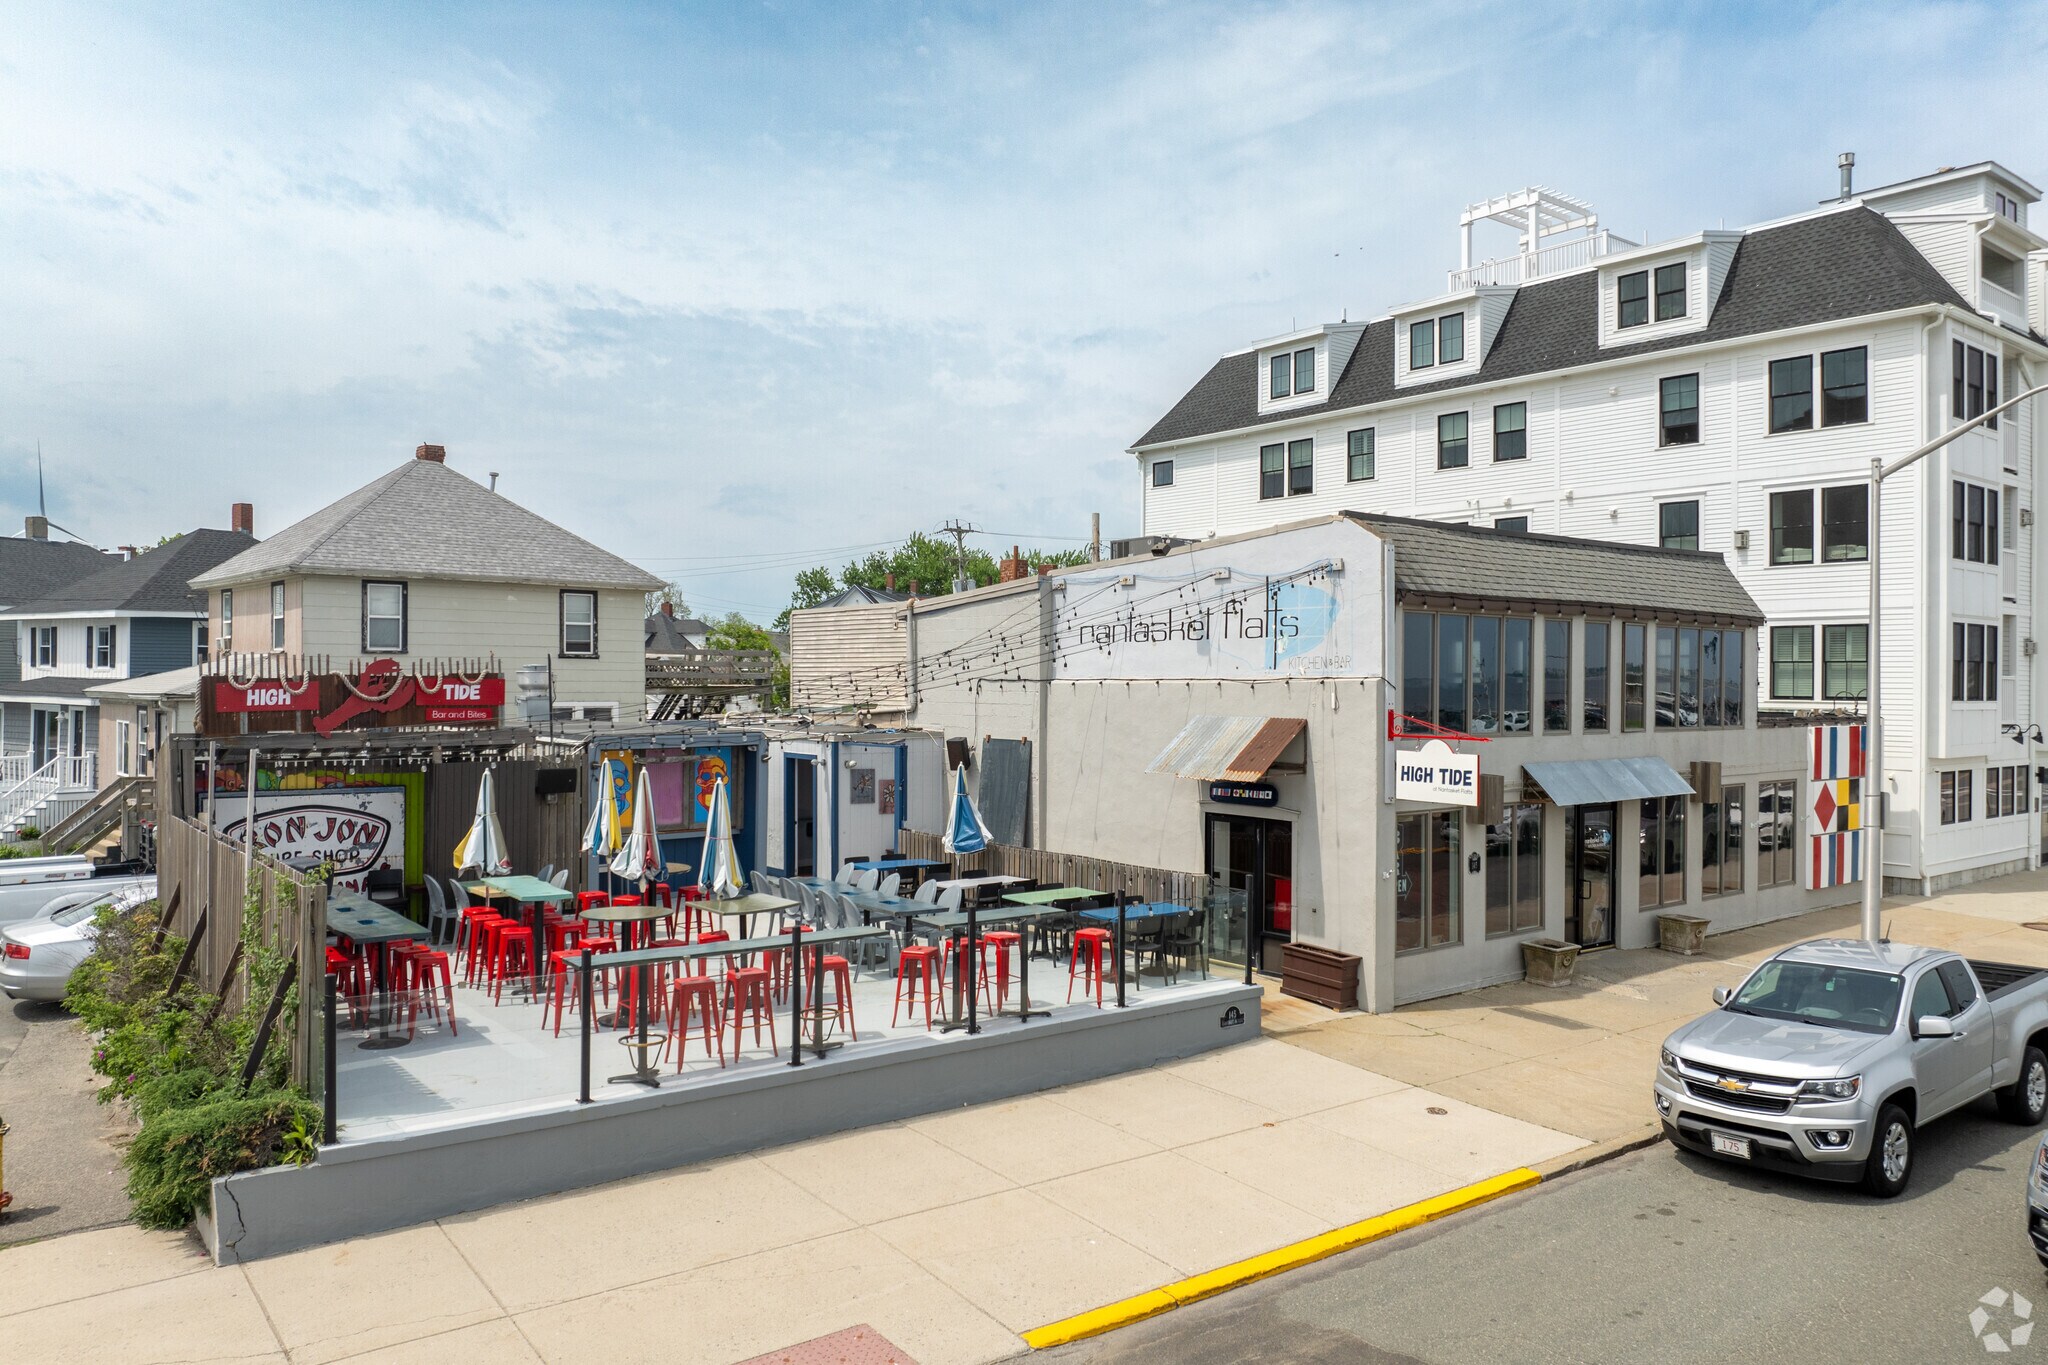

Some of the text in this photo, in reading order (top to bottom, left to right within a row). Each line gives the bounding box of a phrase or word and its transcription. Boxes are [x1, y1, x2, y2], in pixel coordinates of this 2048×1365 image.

[247, 684, 481, 706] HIGH TIDE
[432, 710, 447, 718] Bar
[1401, 766, 1473, 786] HIGH TIDE
[313, 817, 381, 846] JON
[313, 848, 361, 863] SHOP
